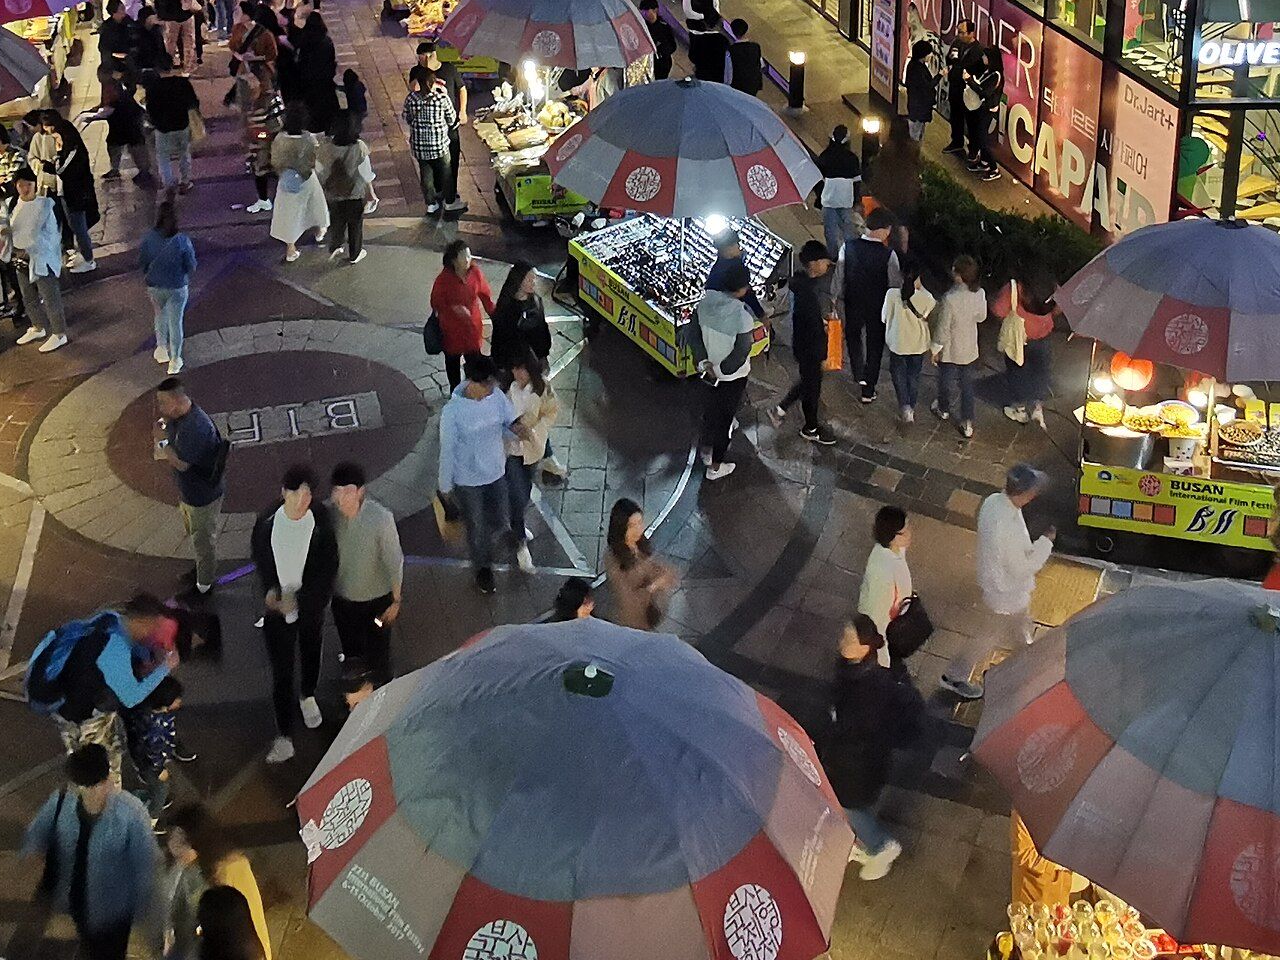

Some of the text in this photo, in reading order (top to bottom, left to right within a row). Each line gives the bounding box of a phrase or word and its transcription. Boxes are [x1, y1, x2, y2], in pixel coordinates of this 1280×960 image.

[1200, 37, 1280, 66] OLIVE
[1125, 83, 1175, 130] Dr.Jart+
[1170, 480, 1225, 496] BUSAN
[1170, 491, 1277, 510] International Film Festi
